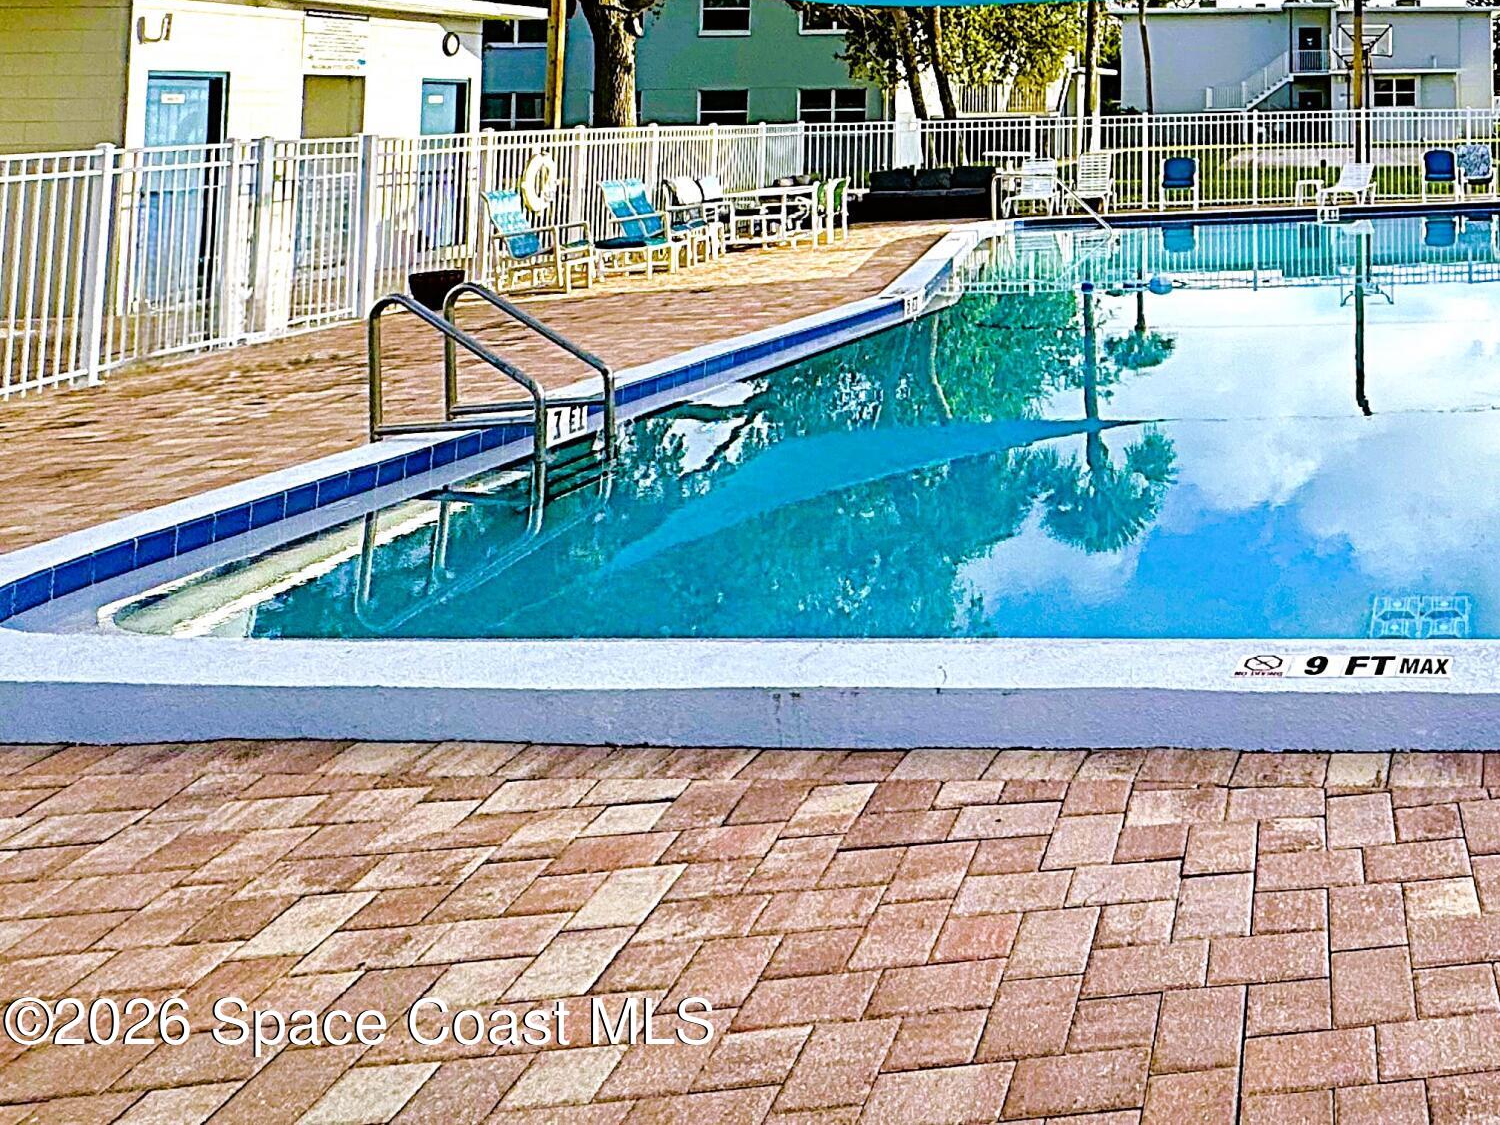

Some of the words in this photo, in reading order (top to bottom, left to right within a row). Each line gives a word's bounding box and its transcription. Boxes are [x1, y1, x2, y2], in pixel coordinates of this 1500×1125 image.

[1304, 655, 1329, 675] 9
[1344, 655, 1397, 676] FT
[1399, 657, 1450, 675] MAX
